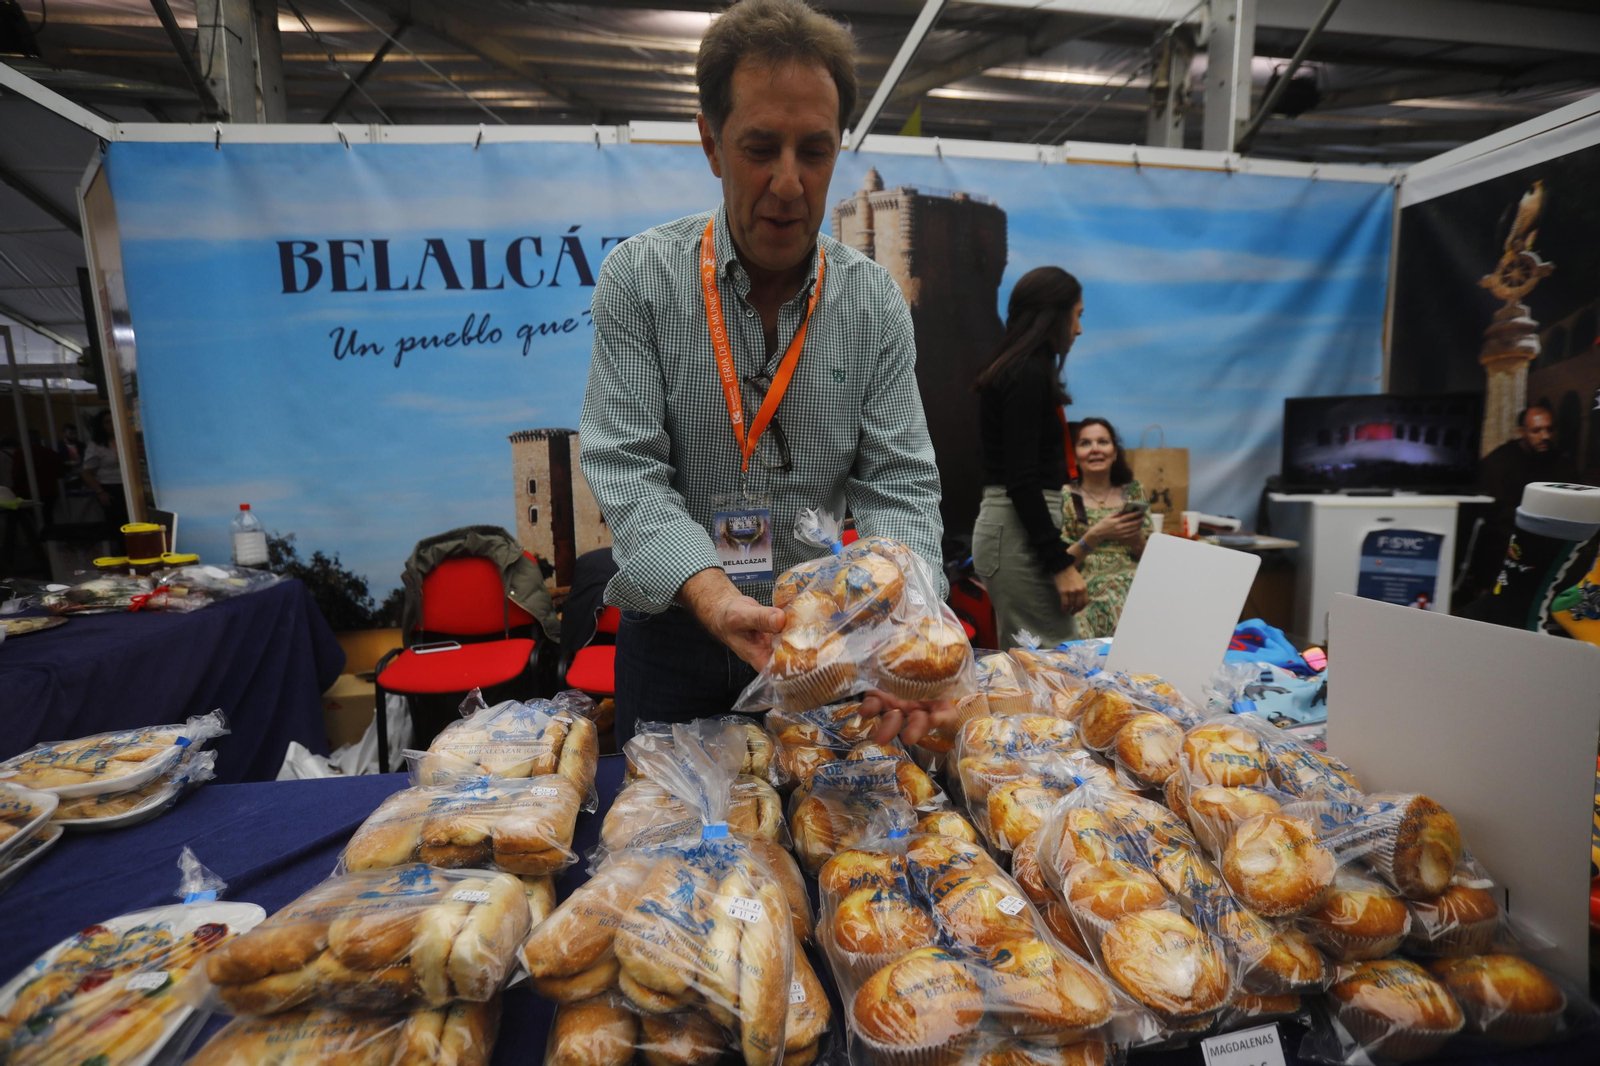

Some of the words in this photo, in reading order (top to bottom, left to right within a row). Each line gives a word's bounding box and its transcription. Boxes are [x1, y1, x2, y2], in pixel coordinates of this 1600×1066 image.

[704, 271, 721, 325] MUNICIPIOS
[329, 326, 384, 360] Un
[394, 313, 502, 368] pueblo
[516, 318, 579, 356] que
[712, 326, 724, 343] LOS
[717, 344, 728, 356] DE
[721, 357, 734, 383] FERIA
[825, 765, 844, 776] DE
[1209, 1034, 1274, 1057] MAGDALENAS
